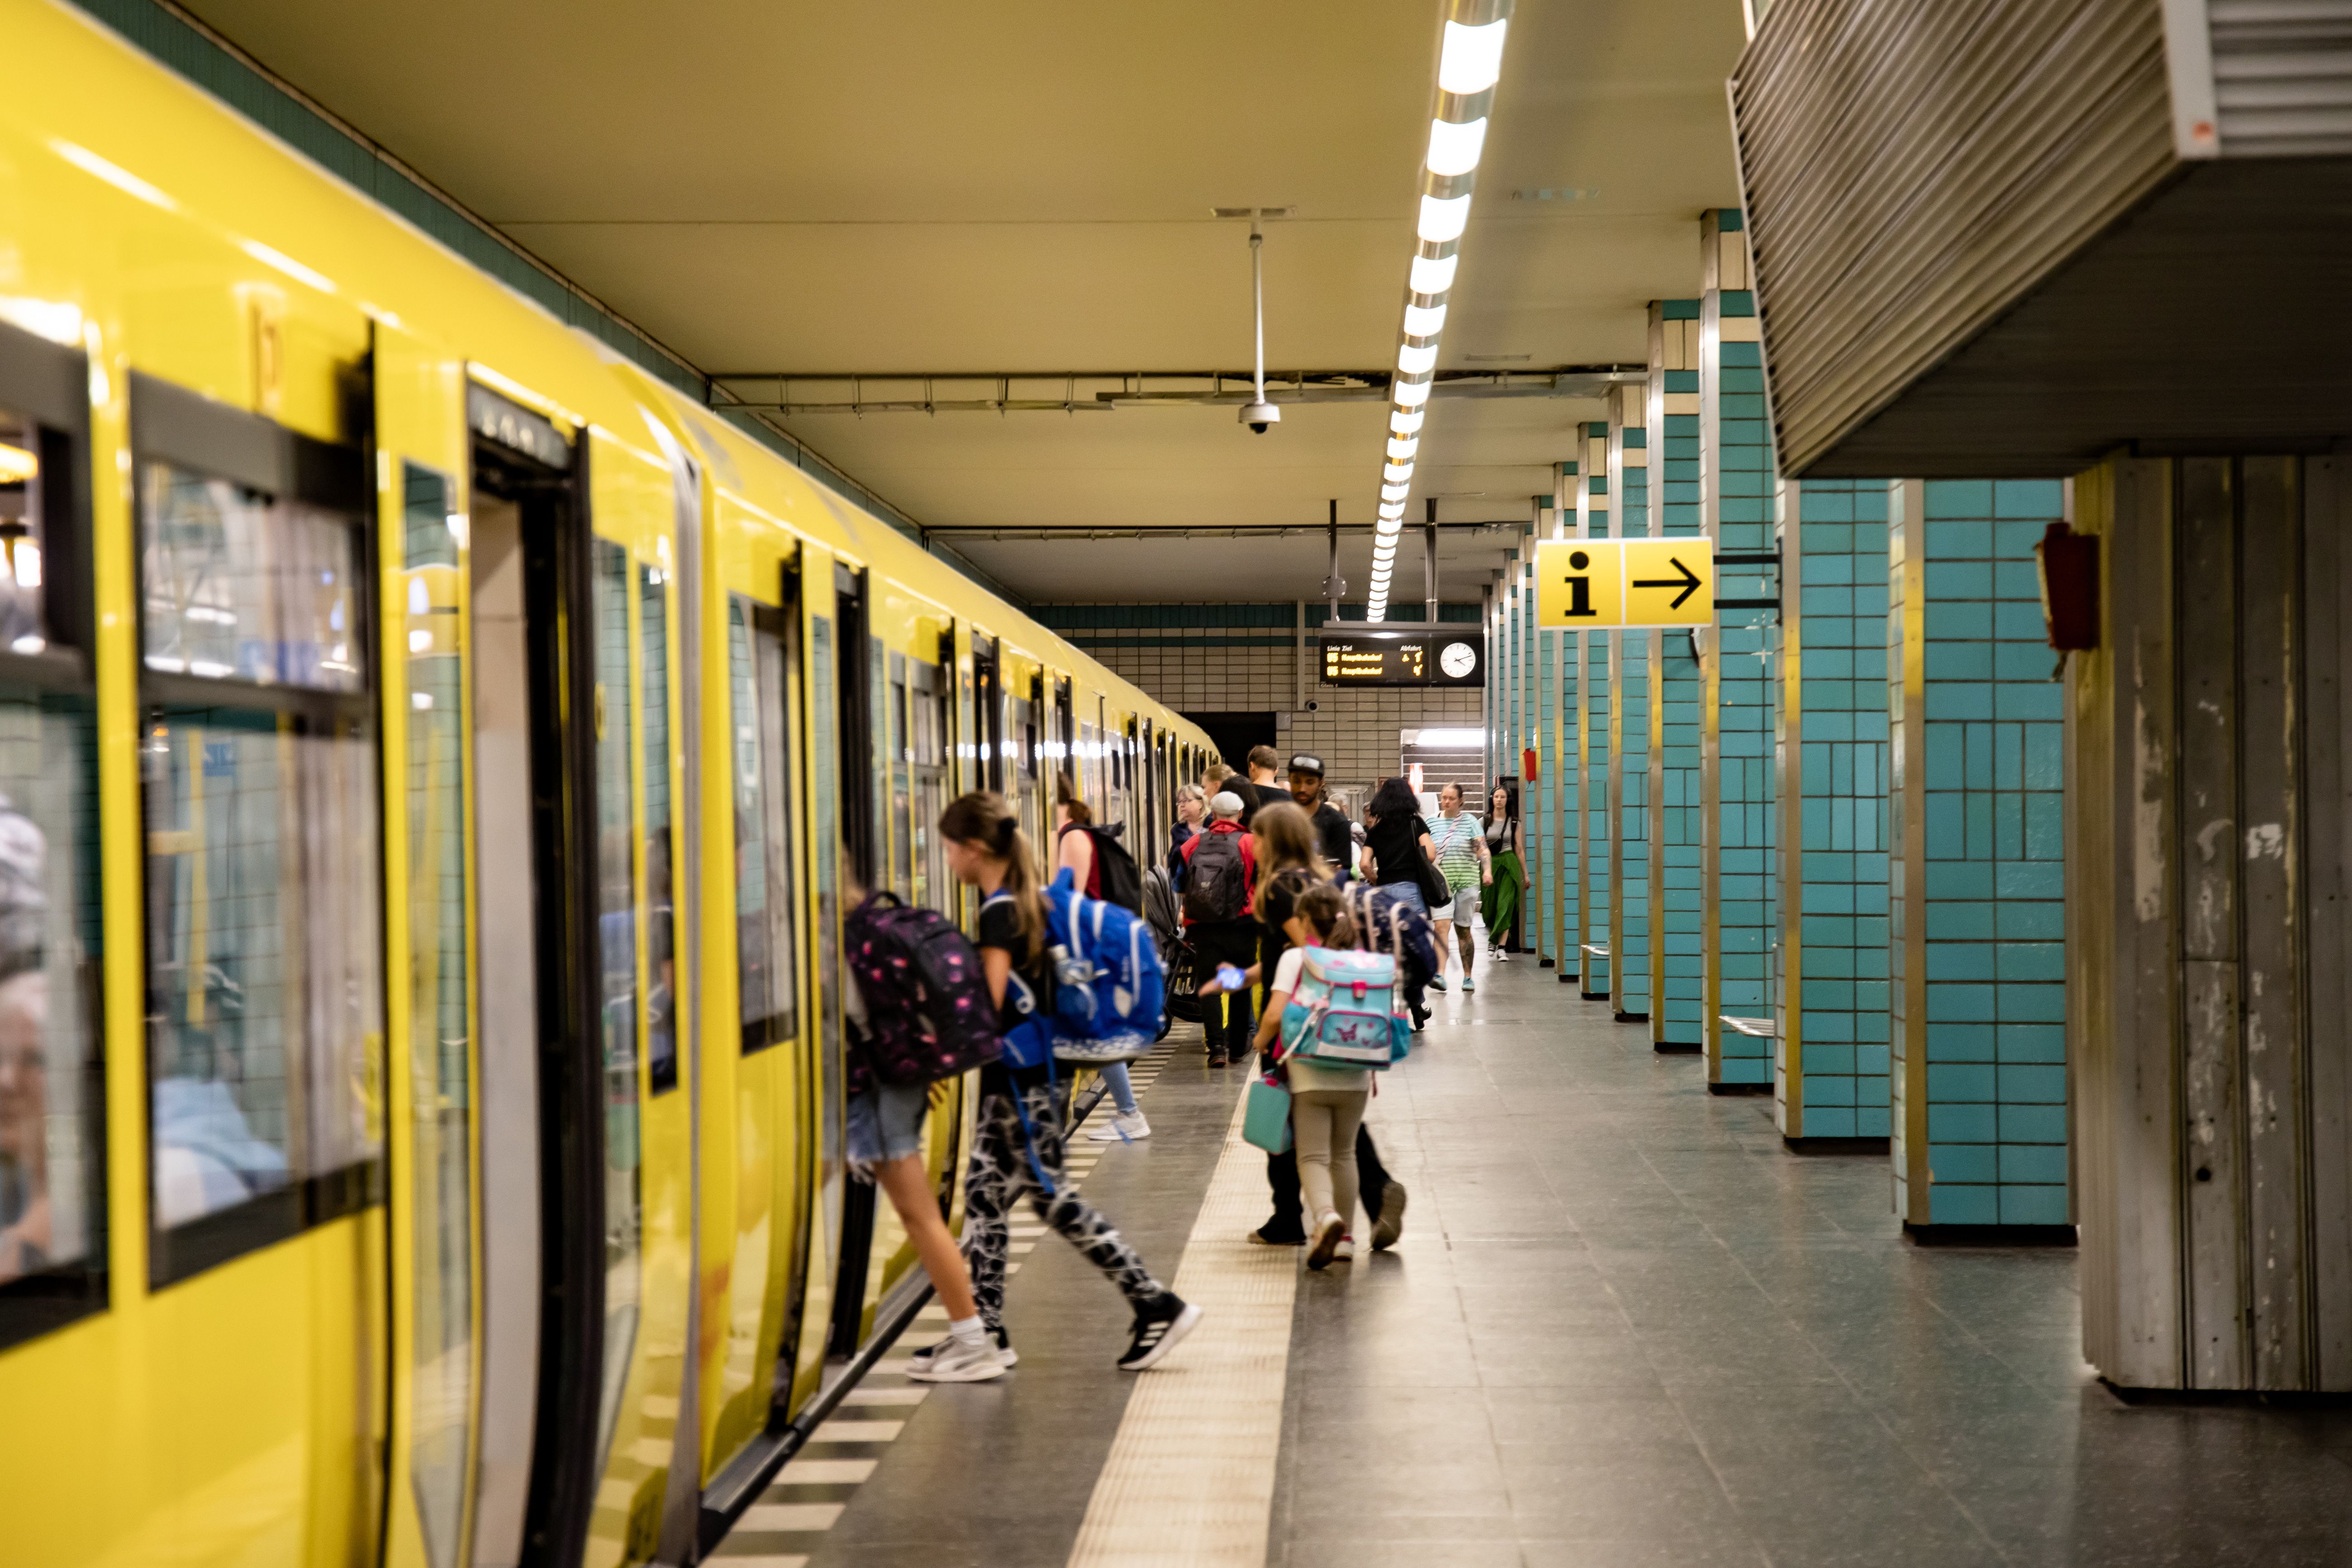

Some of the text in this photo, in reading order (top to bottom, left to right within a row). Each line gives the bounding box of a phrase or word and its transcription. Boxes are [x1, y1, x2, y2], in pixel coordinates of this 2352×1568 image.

[1327, 652, 1339, 663] U5
[1341, 654, 1383, 662] Hauptbahnhof
[1327, 666, 1339, 676] U5
[1341, 667, 1383, 676] Hauptbahnhof
